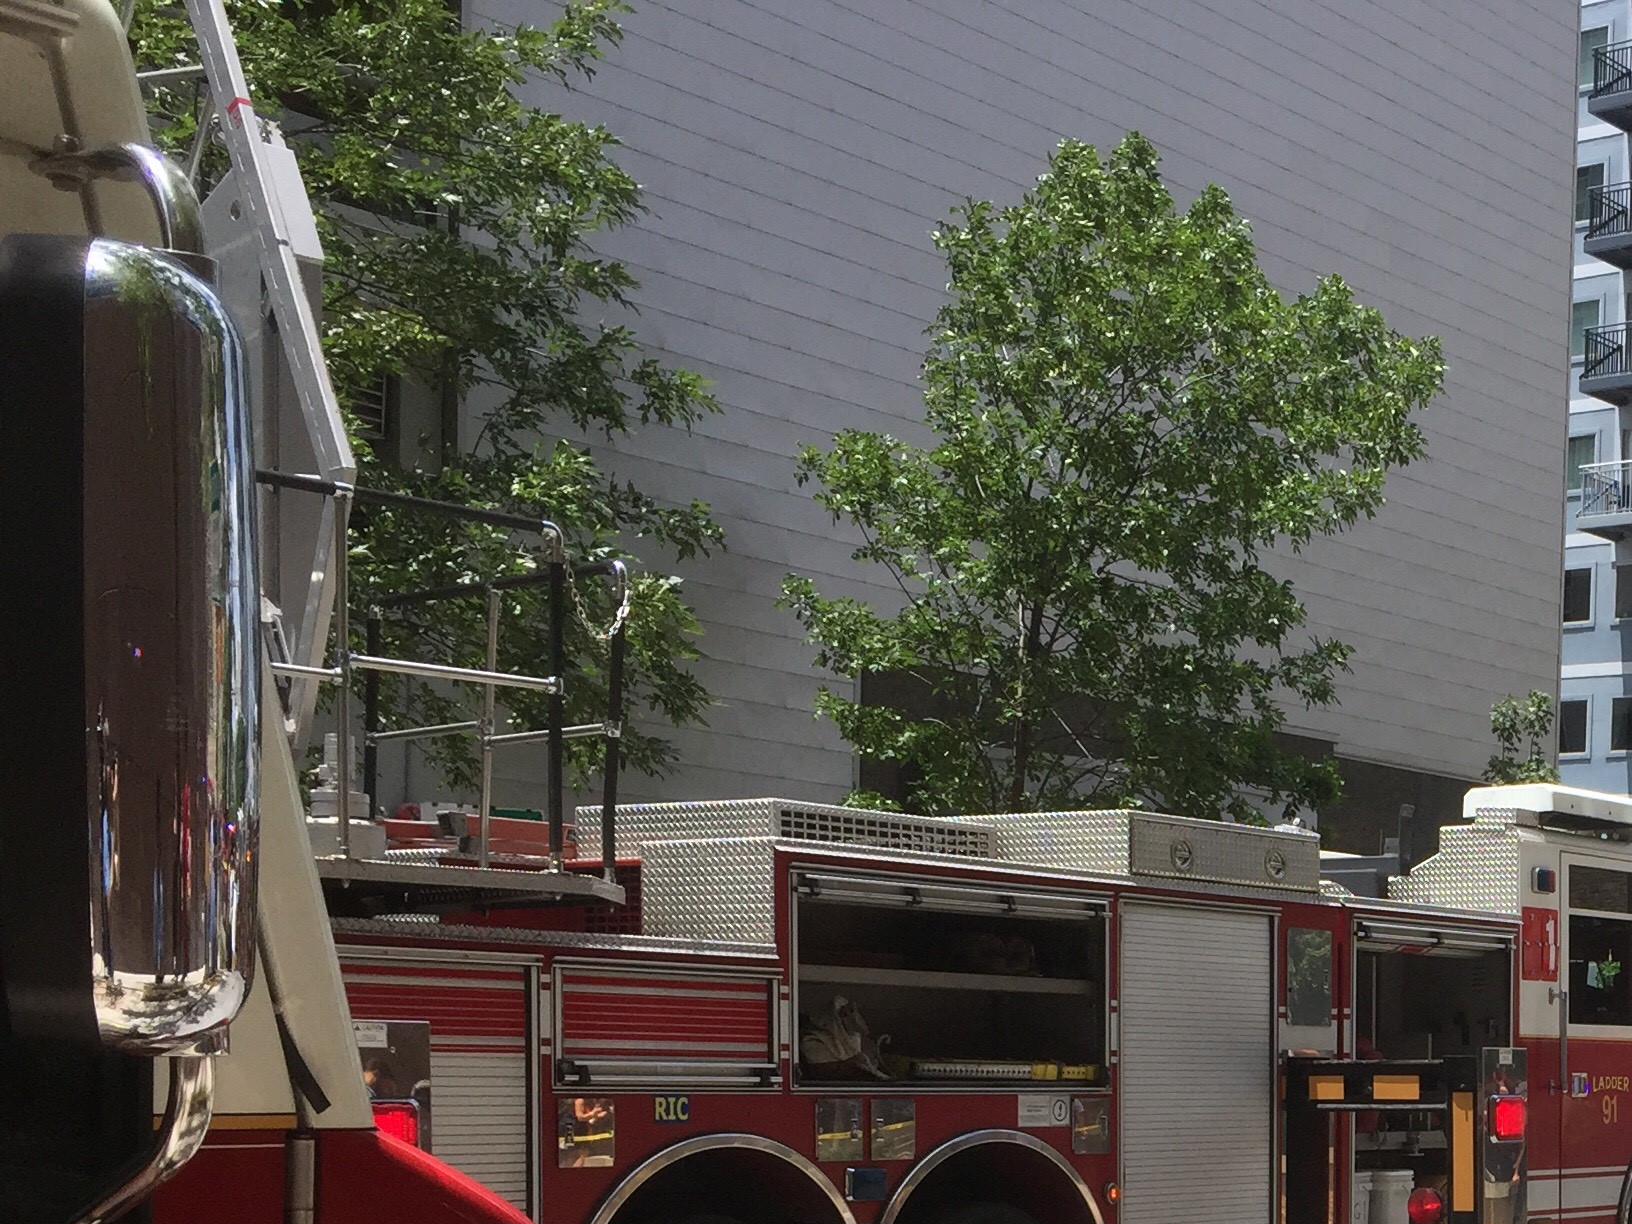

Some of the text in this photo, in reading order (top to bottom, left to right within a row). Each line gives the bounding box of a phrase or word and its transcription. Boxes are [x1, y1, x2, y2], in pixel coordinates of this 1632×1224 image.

[1592, 1076, 1630, 1093] LADDER
[655, 1096, 689, 1121] RIC
[1602, 1094, 1618, 1124] 91
